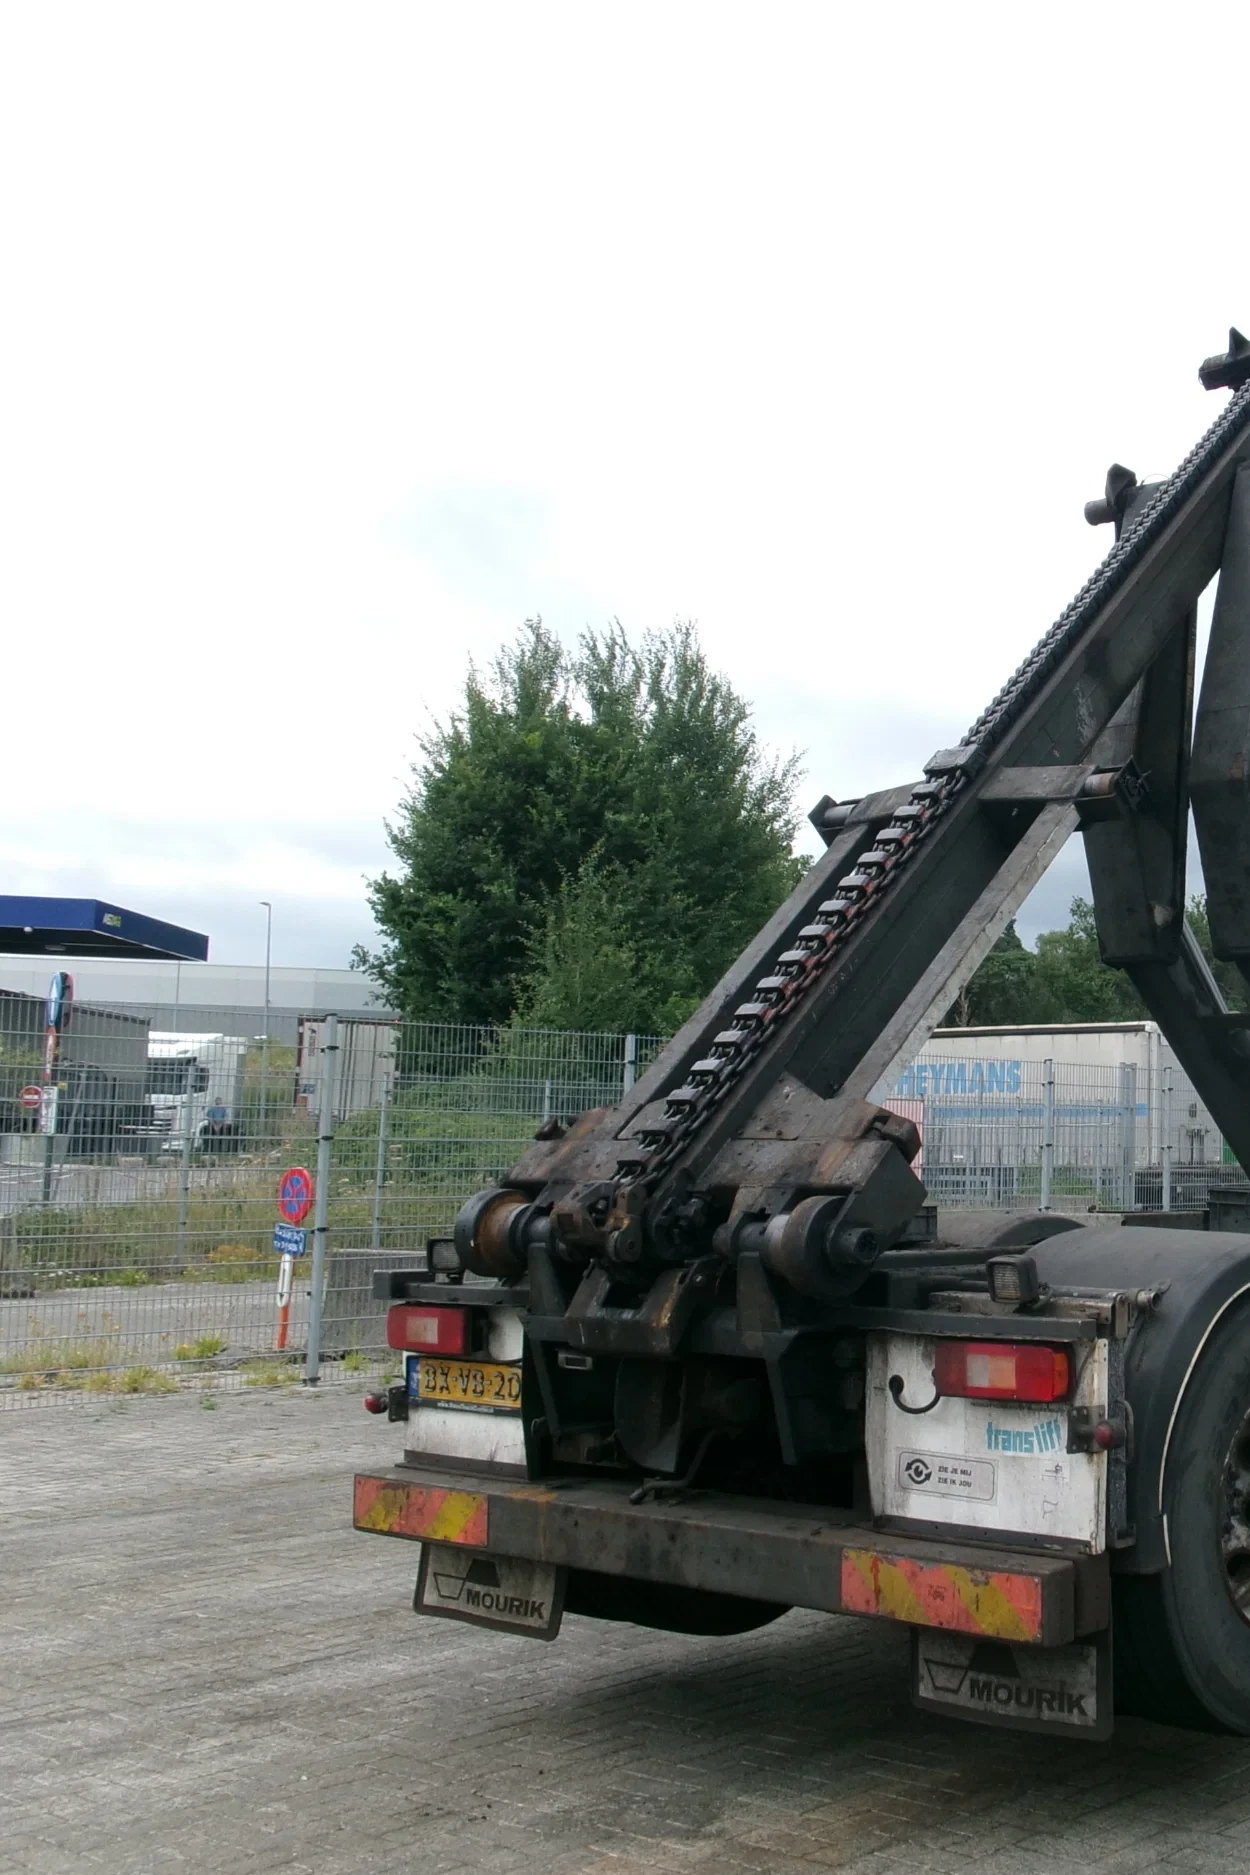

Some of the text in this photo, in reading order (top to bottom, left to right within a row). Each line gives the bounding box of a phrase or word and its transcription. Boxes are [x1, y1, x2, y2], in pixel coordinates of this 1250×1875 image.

[896, 1060, 1022, 1096] HEYMANS
[424, 1364, 520, 1402] BX-VB-20
[985, 1419, 1062, 1454] translift
[937, 1465, 972, 1477] ZIE JE MIJ
[937, 1476, 972, 1488] ZIE IK JOU
[465, 1588, 545, 1620] MOURIK
[969, 1678, 1089, 1717] MOURIK
